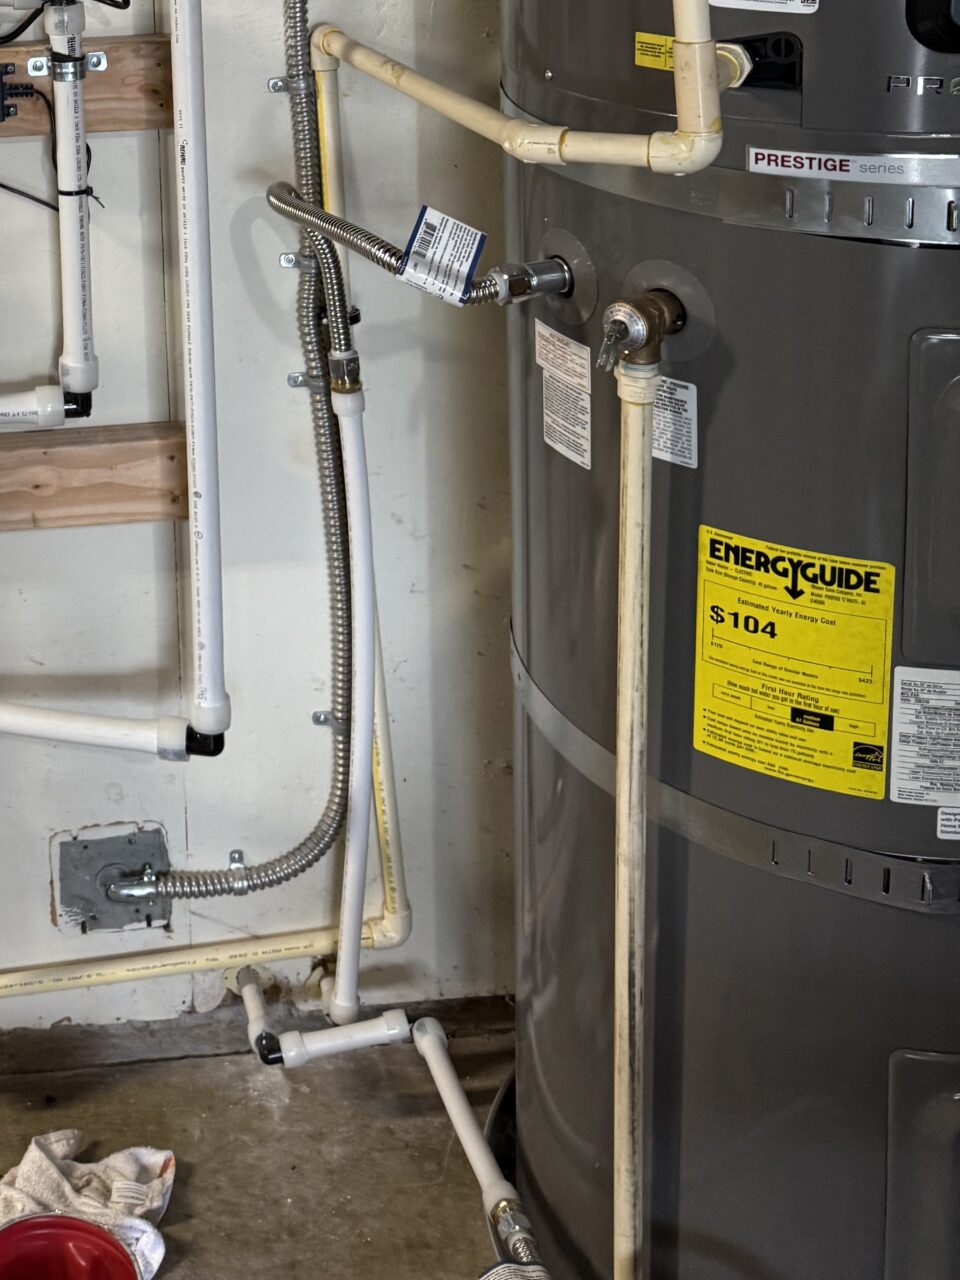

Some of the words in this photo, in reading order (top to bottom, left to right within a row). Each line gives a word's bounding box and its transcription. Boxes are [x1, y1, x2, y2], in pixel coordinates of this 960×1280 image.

[754, 153, 850, 173] PRESTIGE
[859, 162, 905, 174] series
[709, 538, 881, 595] ENERGYGUIDE
[709, 605, 778, 639] $104
[737, 597, 769, 612] Estimated
[772, 606, 792, 618] Yearly
[795, 611, 818, 626] Energy
[820, 616, 836, 626] Cost
[761, 683, 777, 694] First
[778, 688, 795, 697] Hour
[797, 693, 819, 704] Rating
